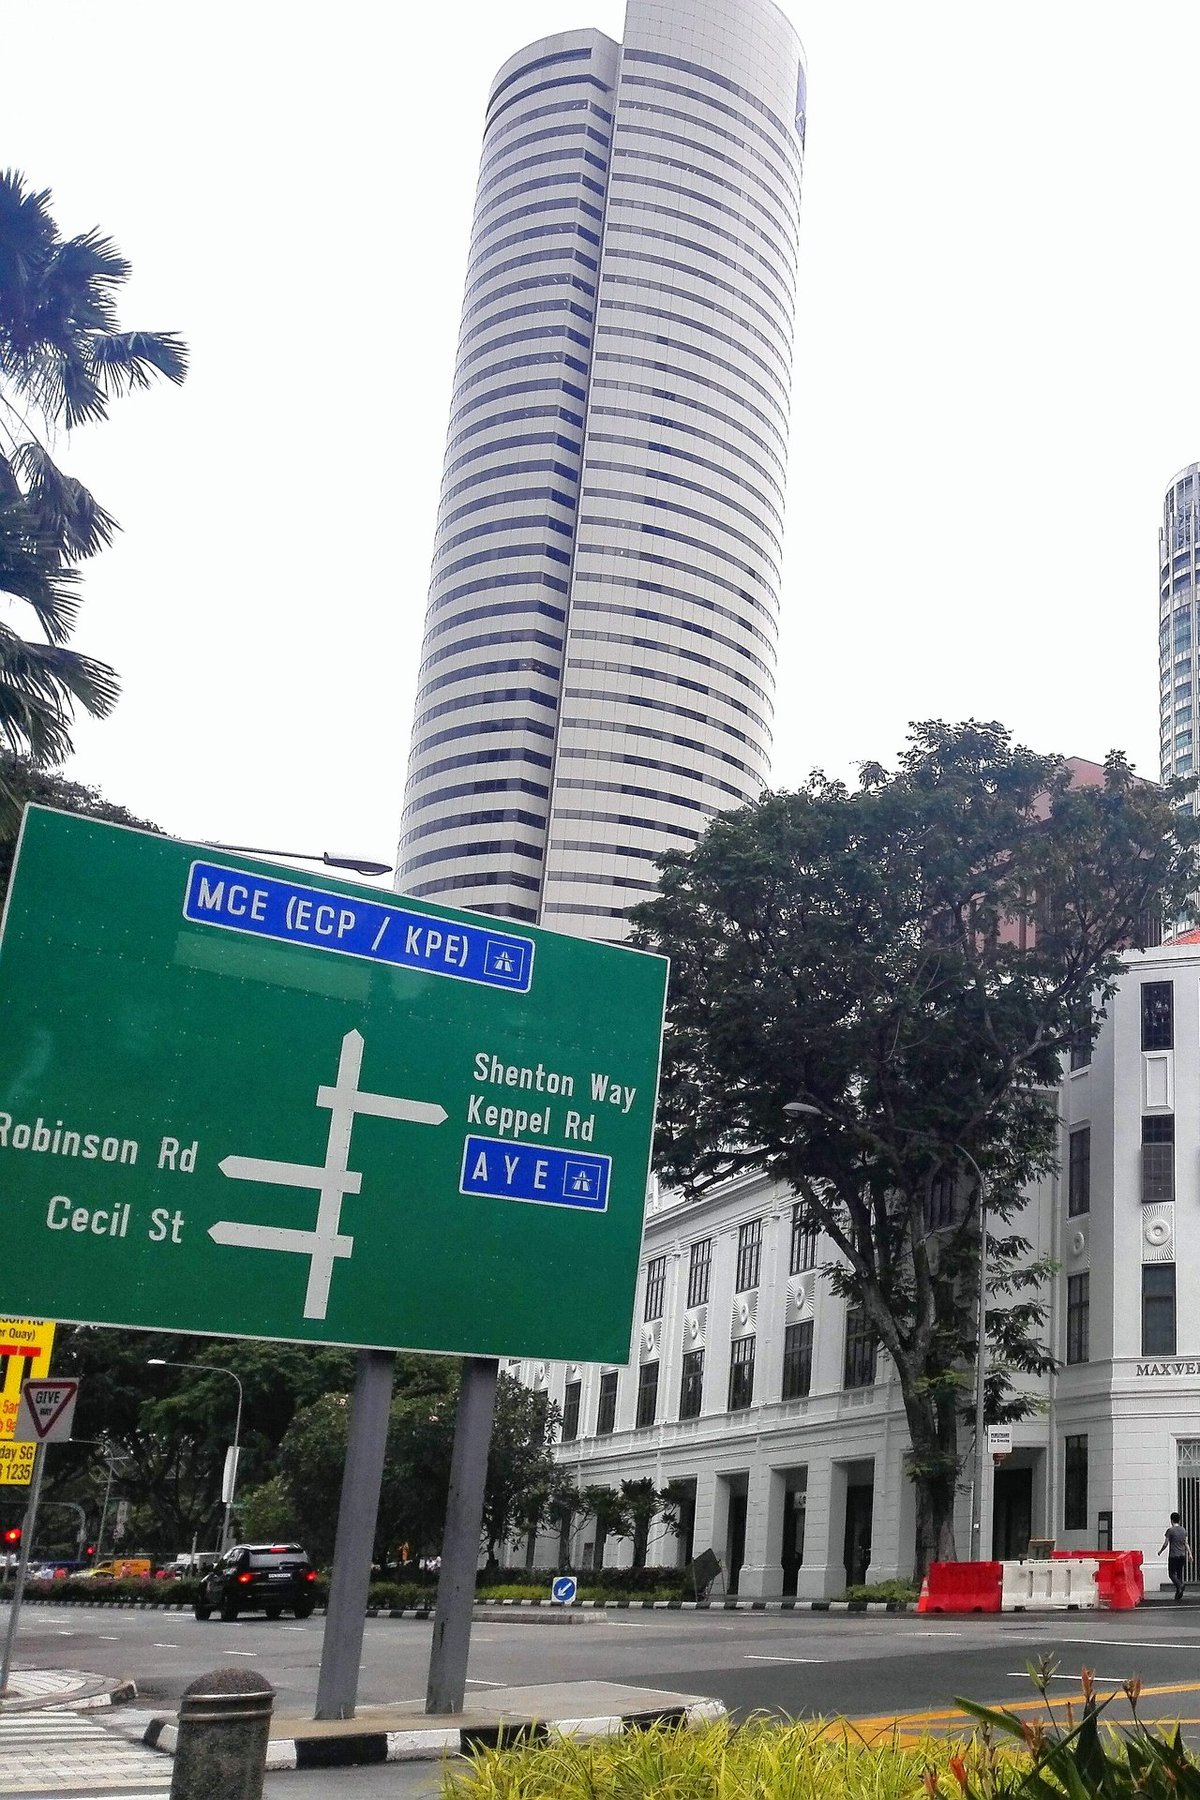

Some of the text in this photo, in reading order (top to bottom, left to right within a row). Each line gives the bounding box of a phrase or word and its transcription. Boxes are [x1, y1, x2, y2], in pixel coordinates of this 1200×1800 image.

[197, 877, 469, 967] MCE (ECP / KPE)
[473, 1052, 636, 1114] Shenton Way
[467, 1094, 595, 1141] Keppel Rd
[0, 1111, 199, 1173] Robinson Rd
[46, 1195, 184, 1244] Cecil St
[9, 1327, 36, 1341] Quay)
[36, 1391, 60, 1404] GIVE
[6, 1464, 31, 1480] 1235
[19, 1446, 34, 1460] SG
